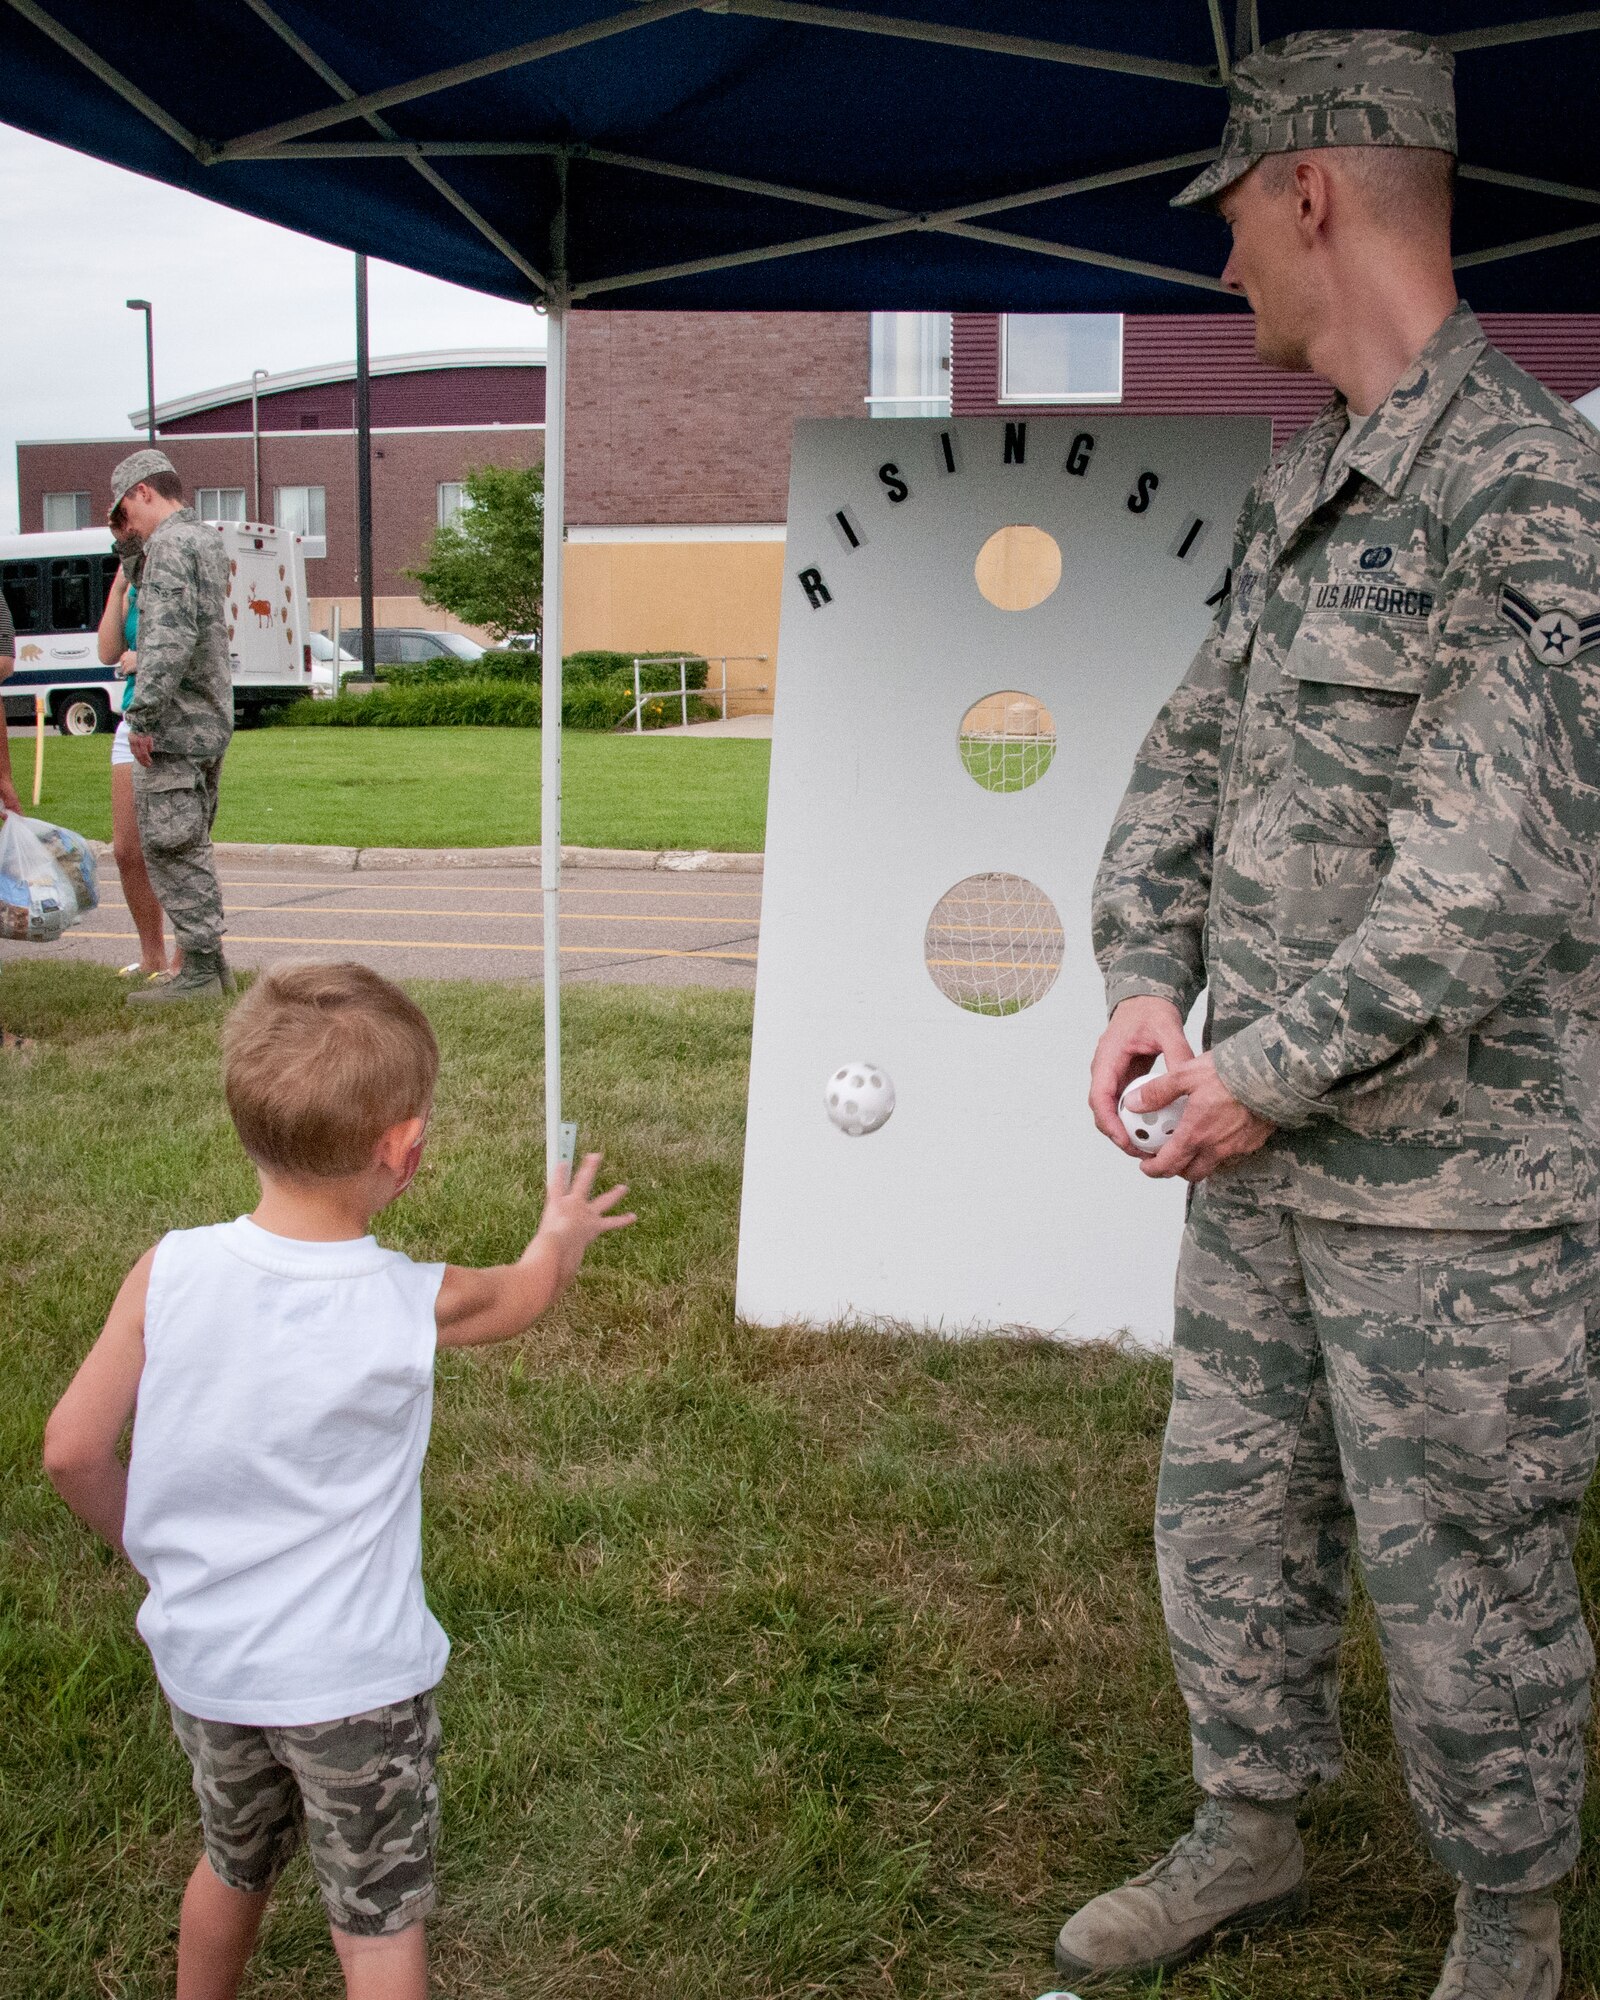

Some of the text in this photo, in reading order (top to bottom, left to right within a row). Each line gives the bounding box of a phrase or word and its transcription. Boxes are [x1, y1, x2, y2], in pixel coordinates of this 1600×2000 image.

[798, 422, 1095, 609] RISING
[1316, 586, 1433, 617] U.S. AIR FORCE
